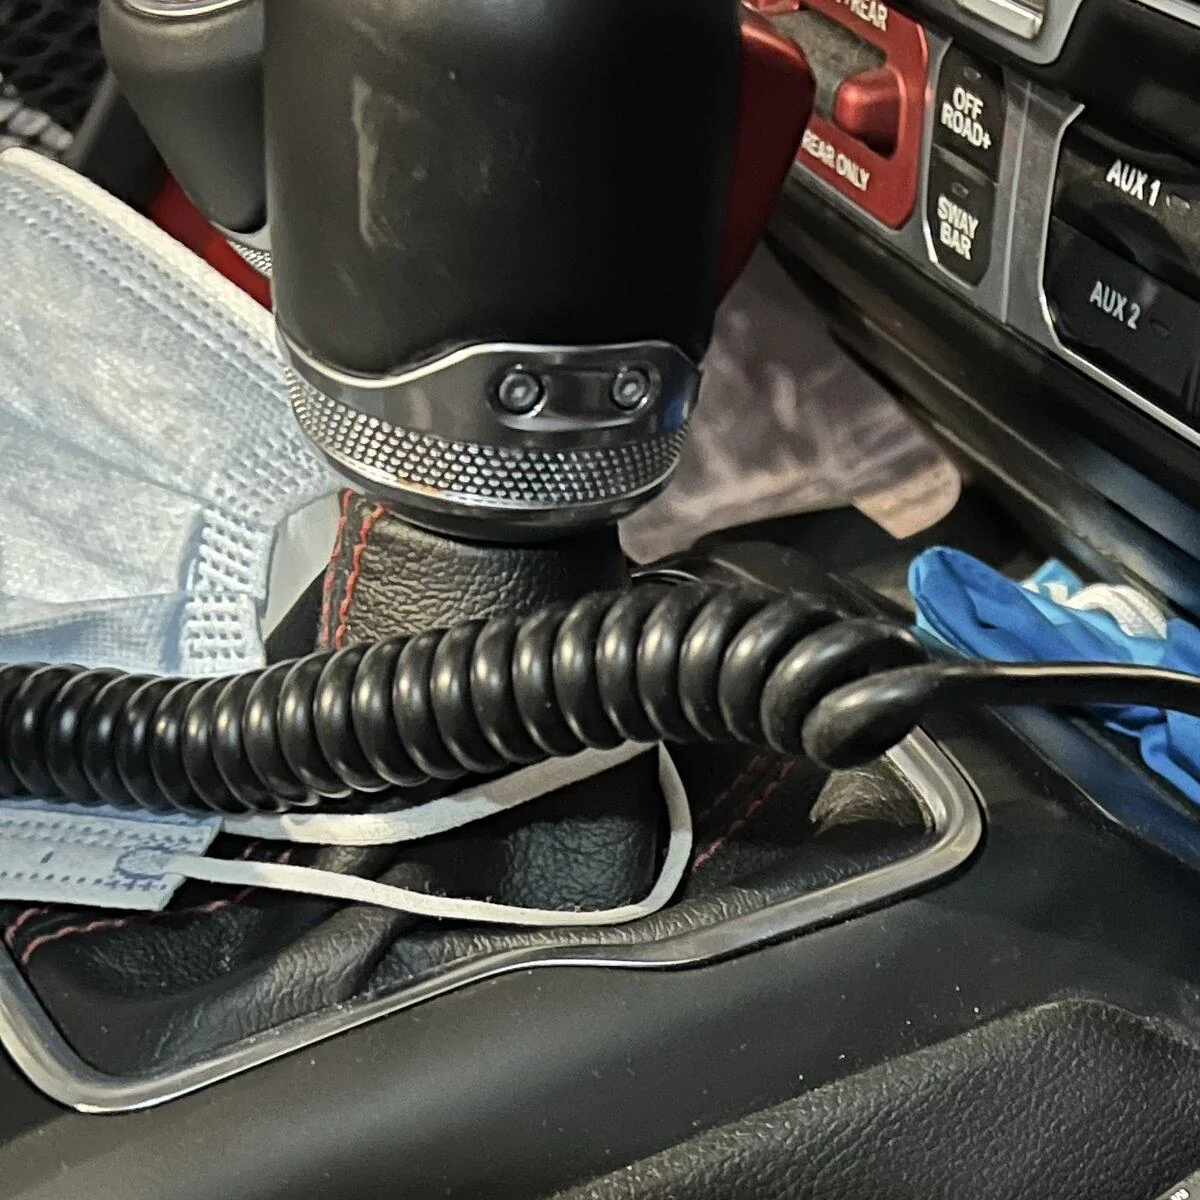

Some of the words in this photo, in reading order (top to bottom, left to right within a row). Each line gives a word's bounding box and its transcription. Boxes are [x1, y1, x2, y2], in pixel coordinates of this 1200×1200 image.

[940, 102, 992, 150] ROAD+
[953, 86, 984, 119] OFF
[801, 128, 836, 169] REAR
[836, 153, 870, 191] ONLY
[1106, 158, 1148, 200] AUX
[1148, 179, 1161, 207] 1
[937, 194, 979, 239] SWAY
[940, 221, 971, 260] BAR
[1090, 280, 1128, 322] AUX
[1127, 303, 1141, 330] 2
